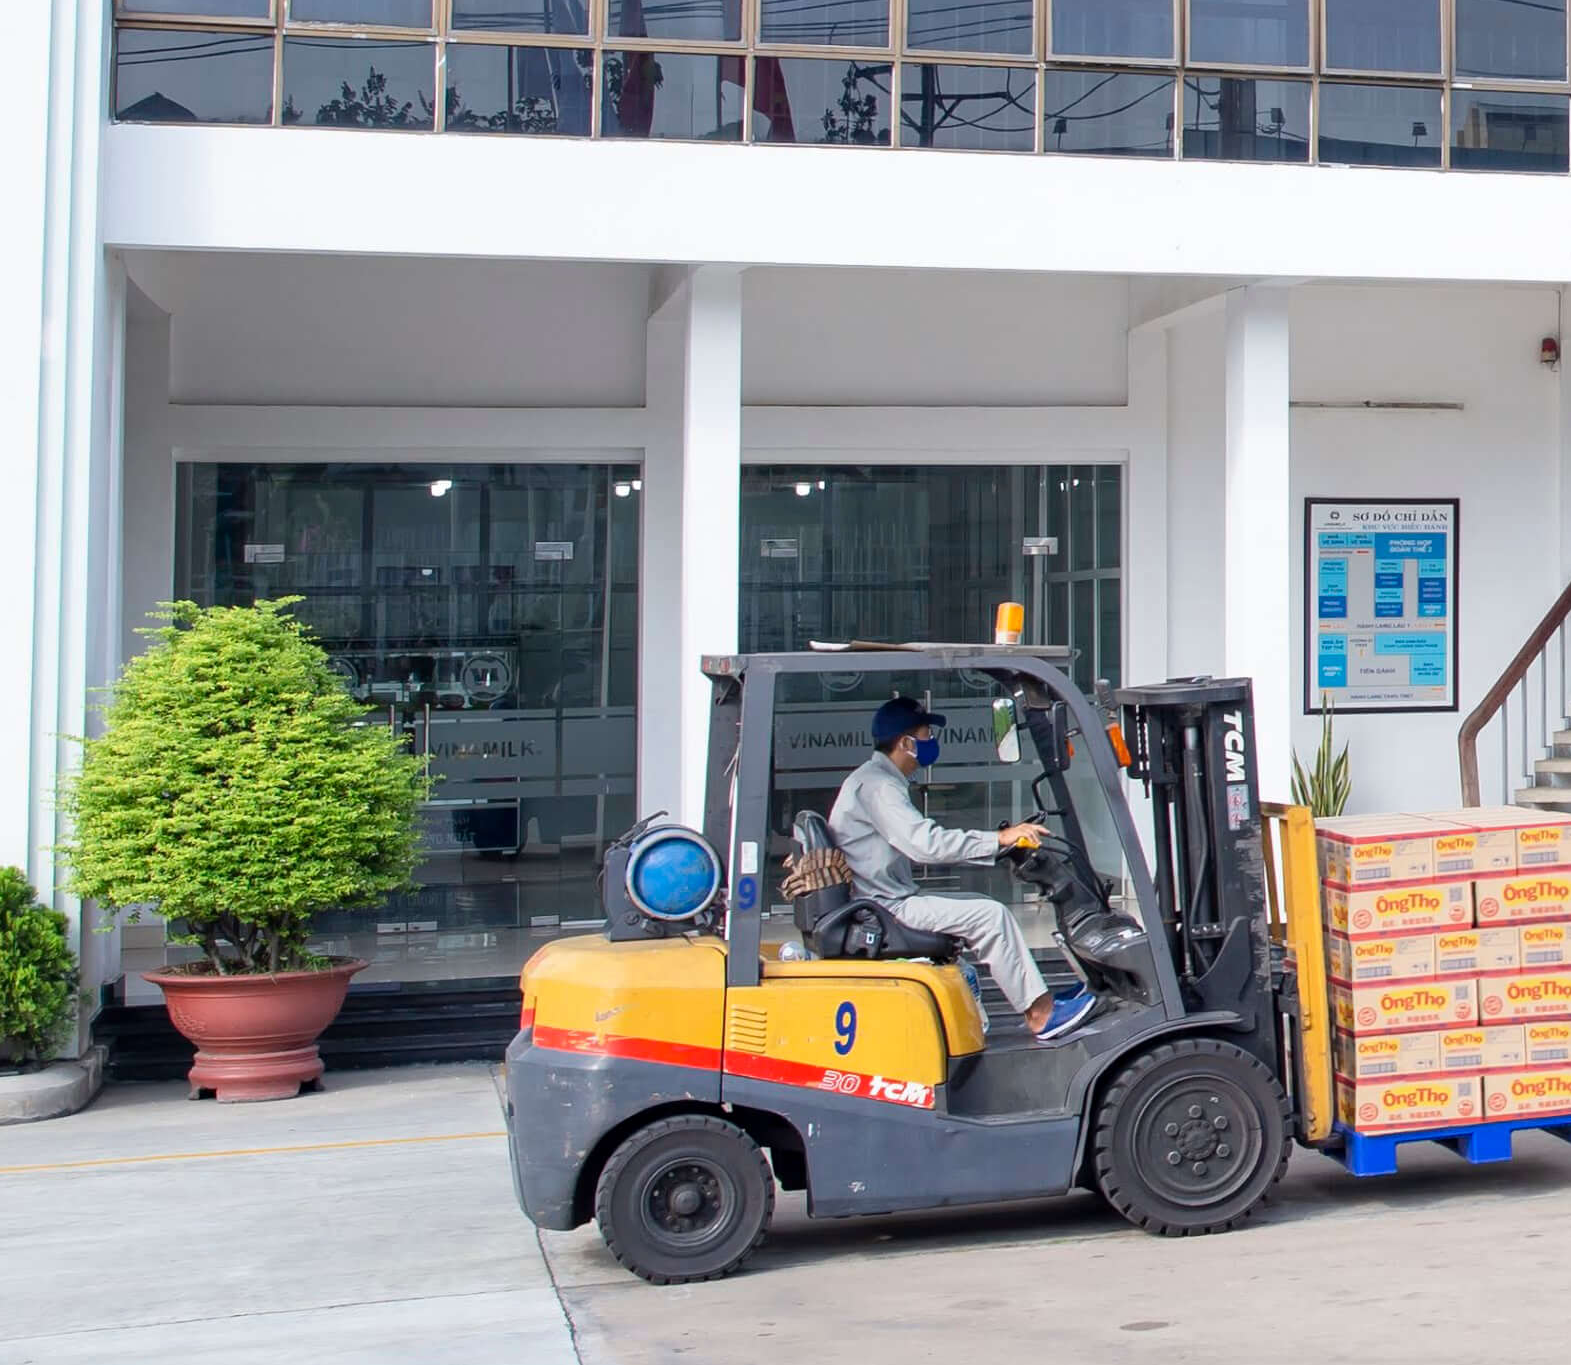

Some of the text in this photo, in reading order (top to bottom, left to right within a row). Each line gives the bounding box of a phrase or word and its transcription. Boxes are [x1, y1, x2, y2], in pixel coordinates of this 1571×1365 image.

[431, 740, 535, 759] VINAMILK
[791, 729, 873, 748] VINAMIL
[1223, 710, 1246, 782] TCM
[738, 876, 757, 910] 9
[834, 1000, 857, 1056] 9
